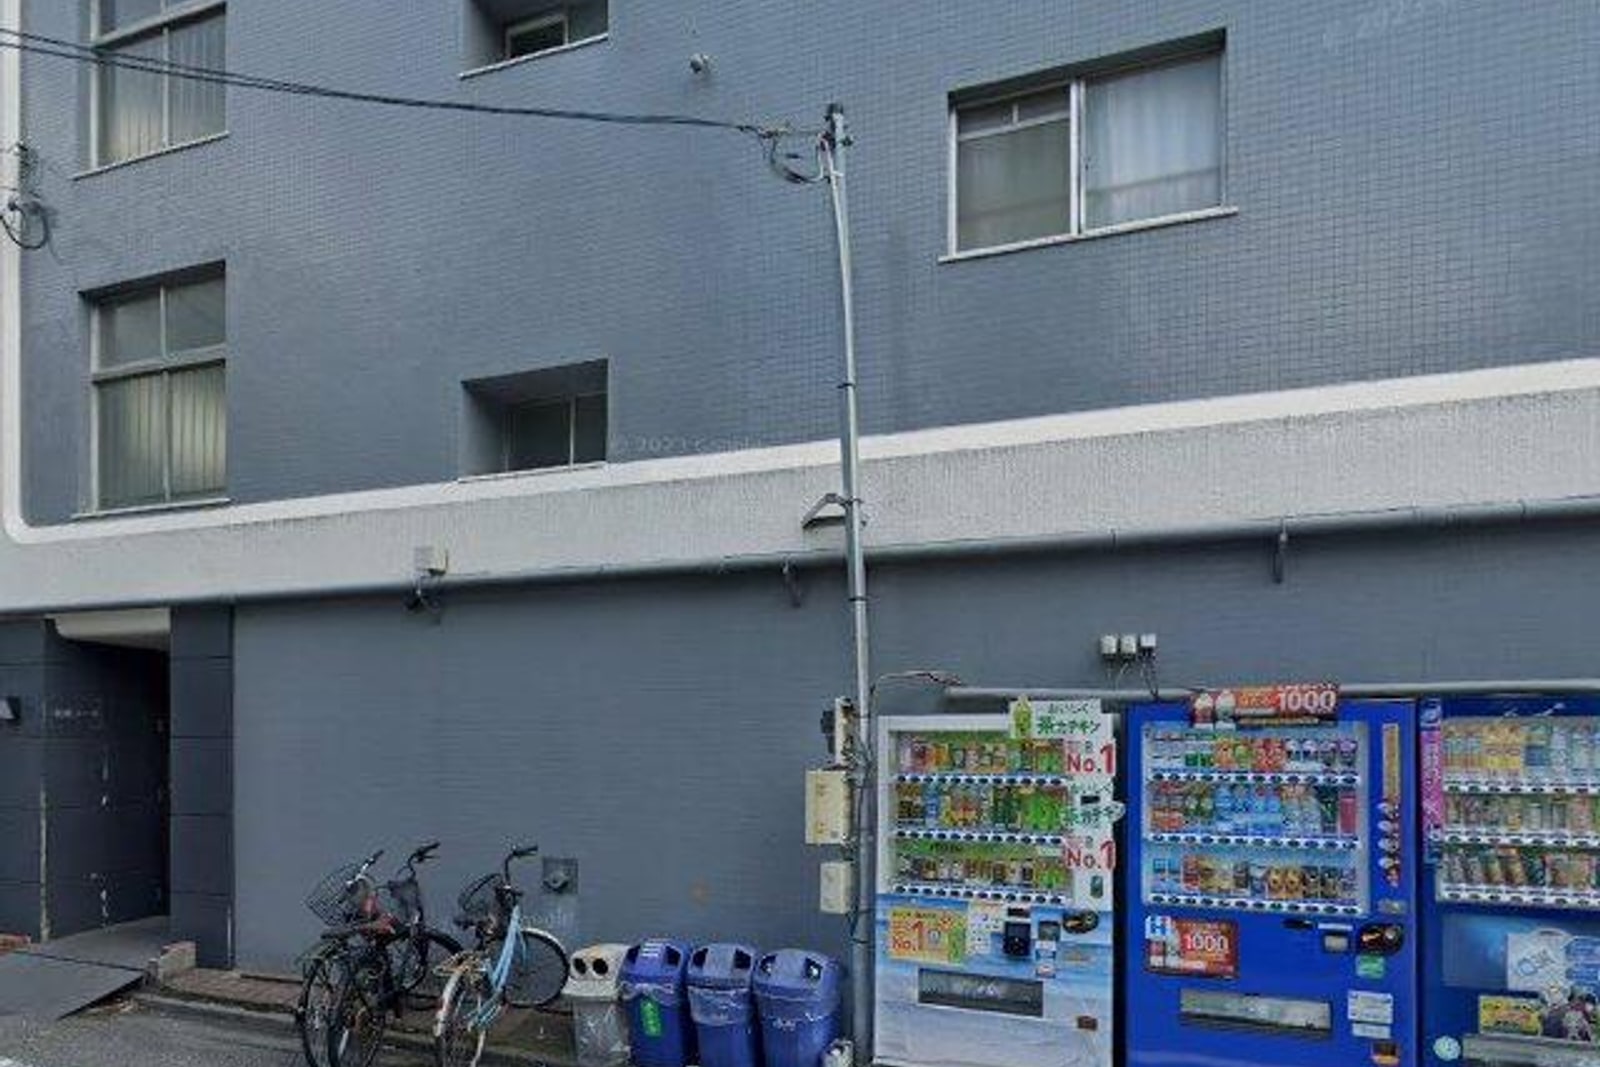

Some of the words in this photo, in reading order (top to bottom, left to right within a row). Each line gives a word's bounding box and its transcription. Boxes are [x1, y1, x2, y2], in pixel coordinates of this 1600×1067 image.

[1279, 689, 1337, 713] 1000
[1067, 742, 1114, 774] No.1
[1067, 839, 1114, 870] No.1
[1183, 931, 1230, 953] 1000
